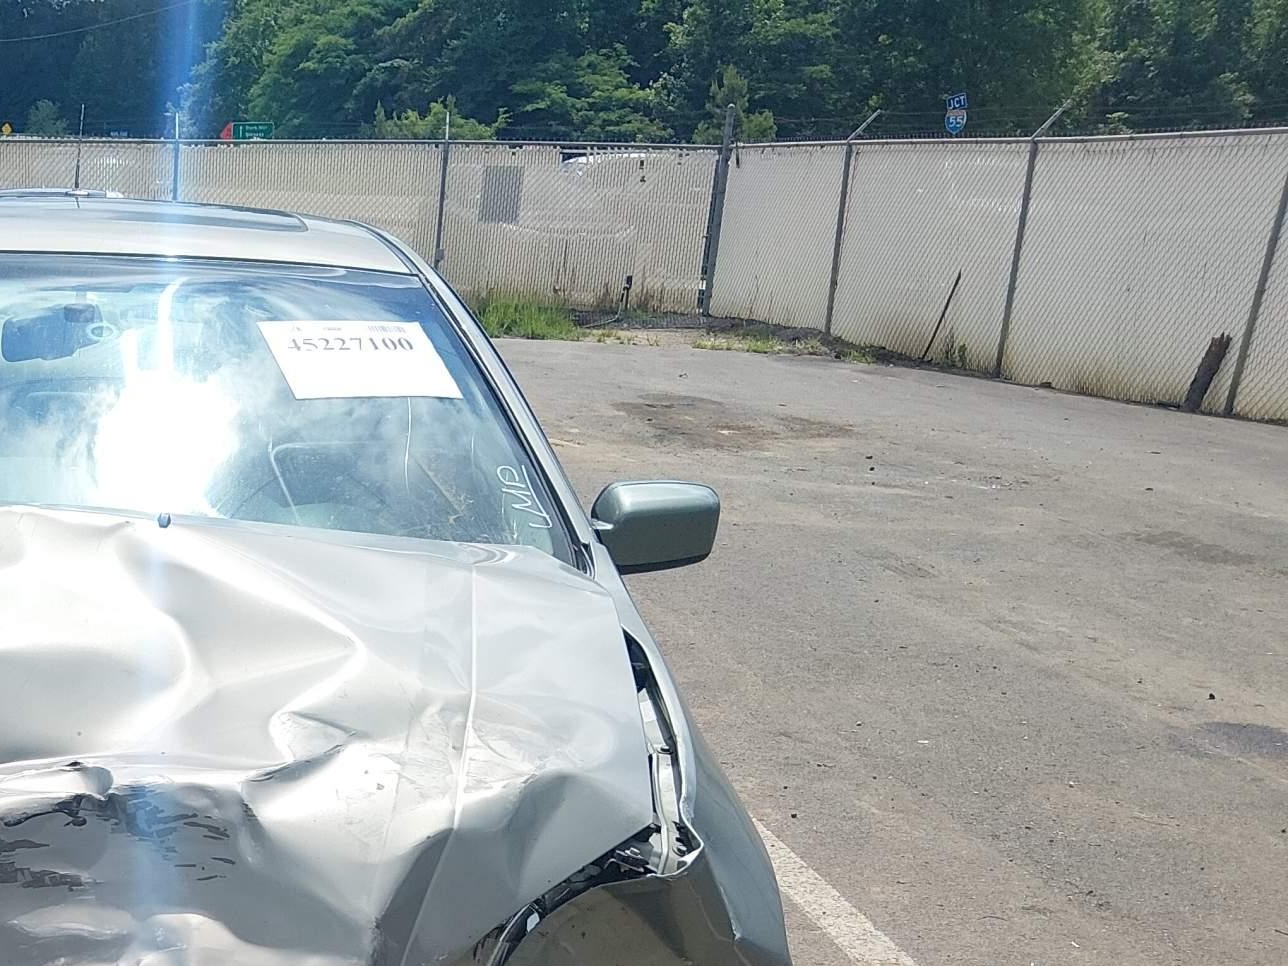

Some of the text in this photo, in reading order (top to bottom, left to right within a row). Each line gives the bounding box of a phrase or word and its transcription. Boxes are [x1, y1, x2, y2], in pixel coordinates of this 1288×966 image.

[948, 96, 965, 109] JCT
[949, 115, 963, 128] 55
[287, 336, 414, 352] 45227100
